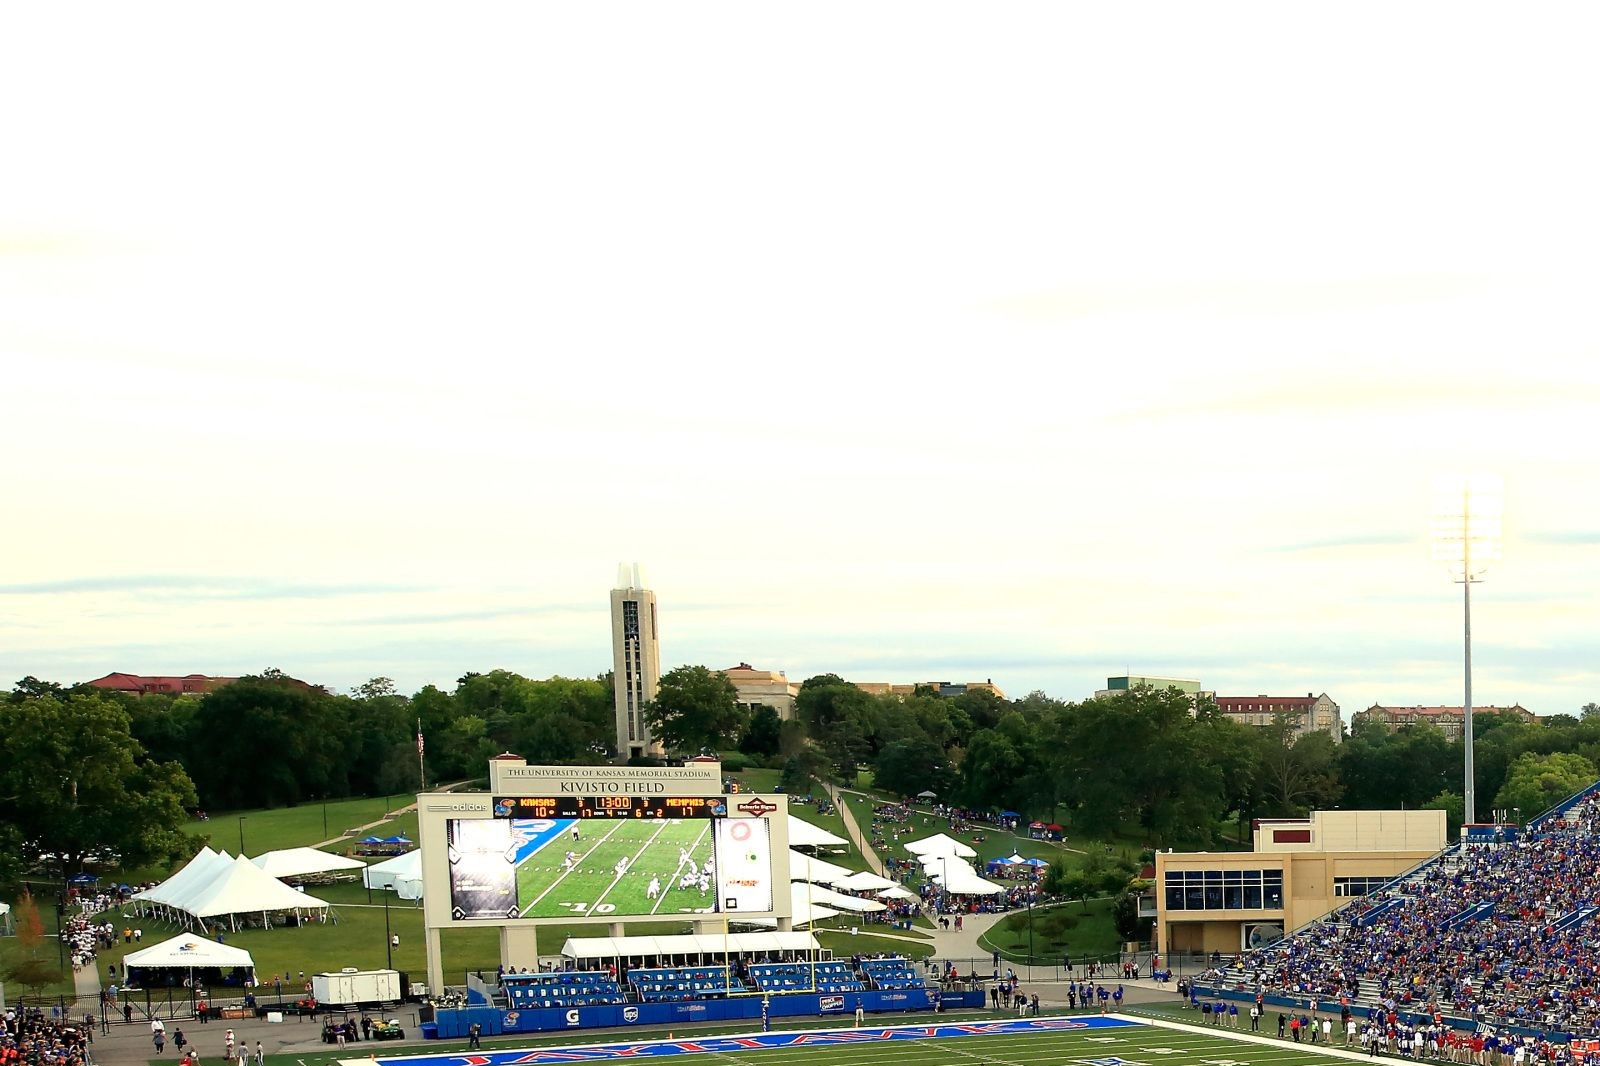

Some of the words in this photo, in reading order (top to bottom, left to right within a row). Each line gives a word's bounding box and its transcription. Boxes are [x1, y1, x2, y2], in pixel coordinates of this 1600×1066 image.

[628, 770, 672, 778] MEMORIAL
[674, 770, 711, 778] STADIUM
[560, 781, 619, 793] KIVISTO
[624, 782, 665, 793] FIELD
[732, 783, 739, 794] 3
[520, 798, 556, 807] KANSAS
[601, 798, 629, 808] 13:00
[666, 798, 705, 807] MEMPHIS
[451, 803, 488, 812] adidas
[535, 807, 546, 817] 10
[682, 807, 693, 816] 17
[582, 809, 592, 817] 17
[607, 809, 613, 817] 4
[656, 809, 663, 818] 2
[566, 1009, 580, 1023] G
[624, 1009, 638, 1020] ups
